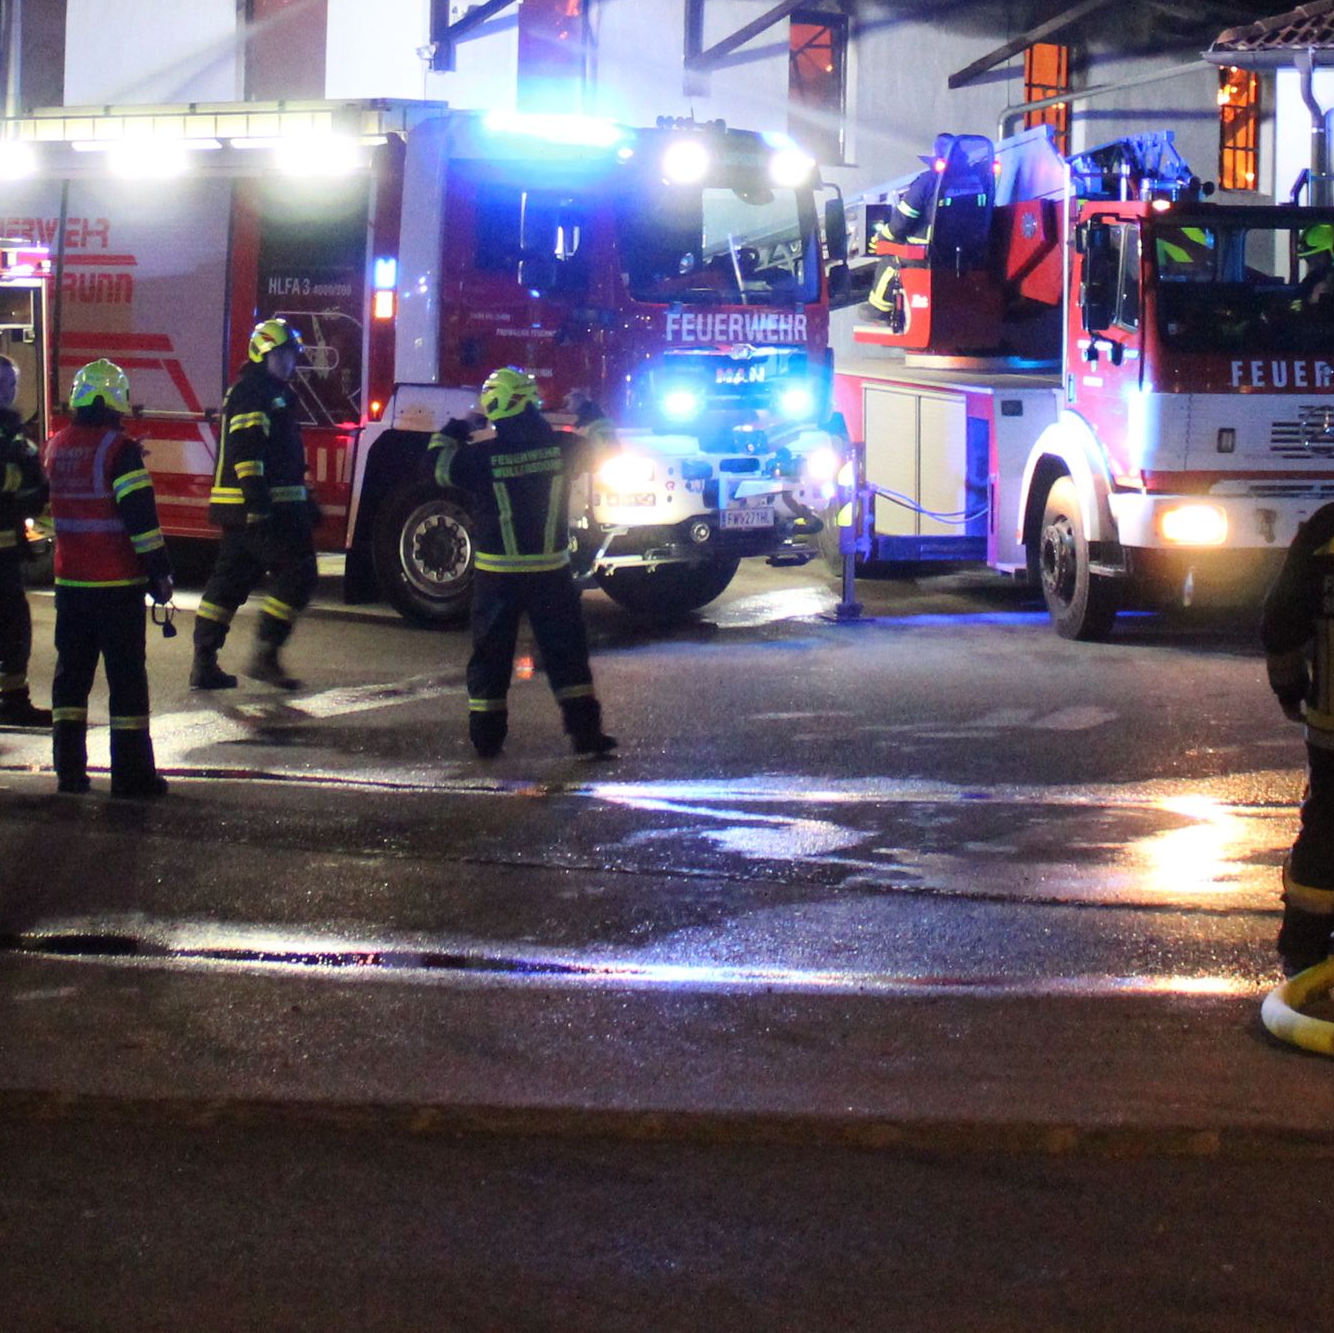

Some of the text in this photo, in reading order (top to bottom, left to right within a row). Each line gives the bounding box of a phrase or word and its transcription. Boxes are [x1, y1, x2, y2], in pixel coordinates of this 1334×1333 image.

[267, 277, 301, 296] HLFA
[302, 277, 312, 296] 3
[666, 313, 808, 342] FEUERWEHR
